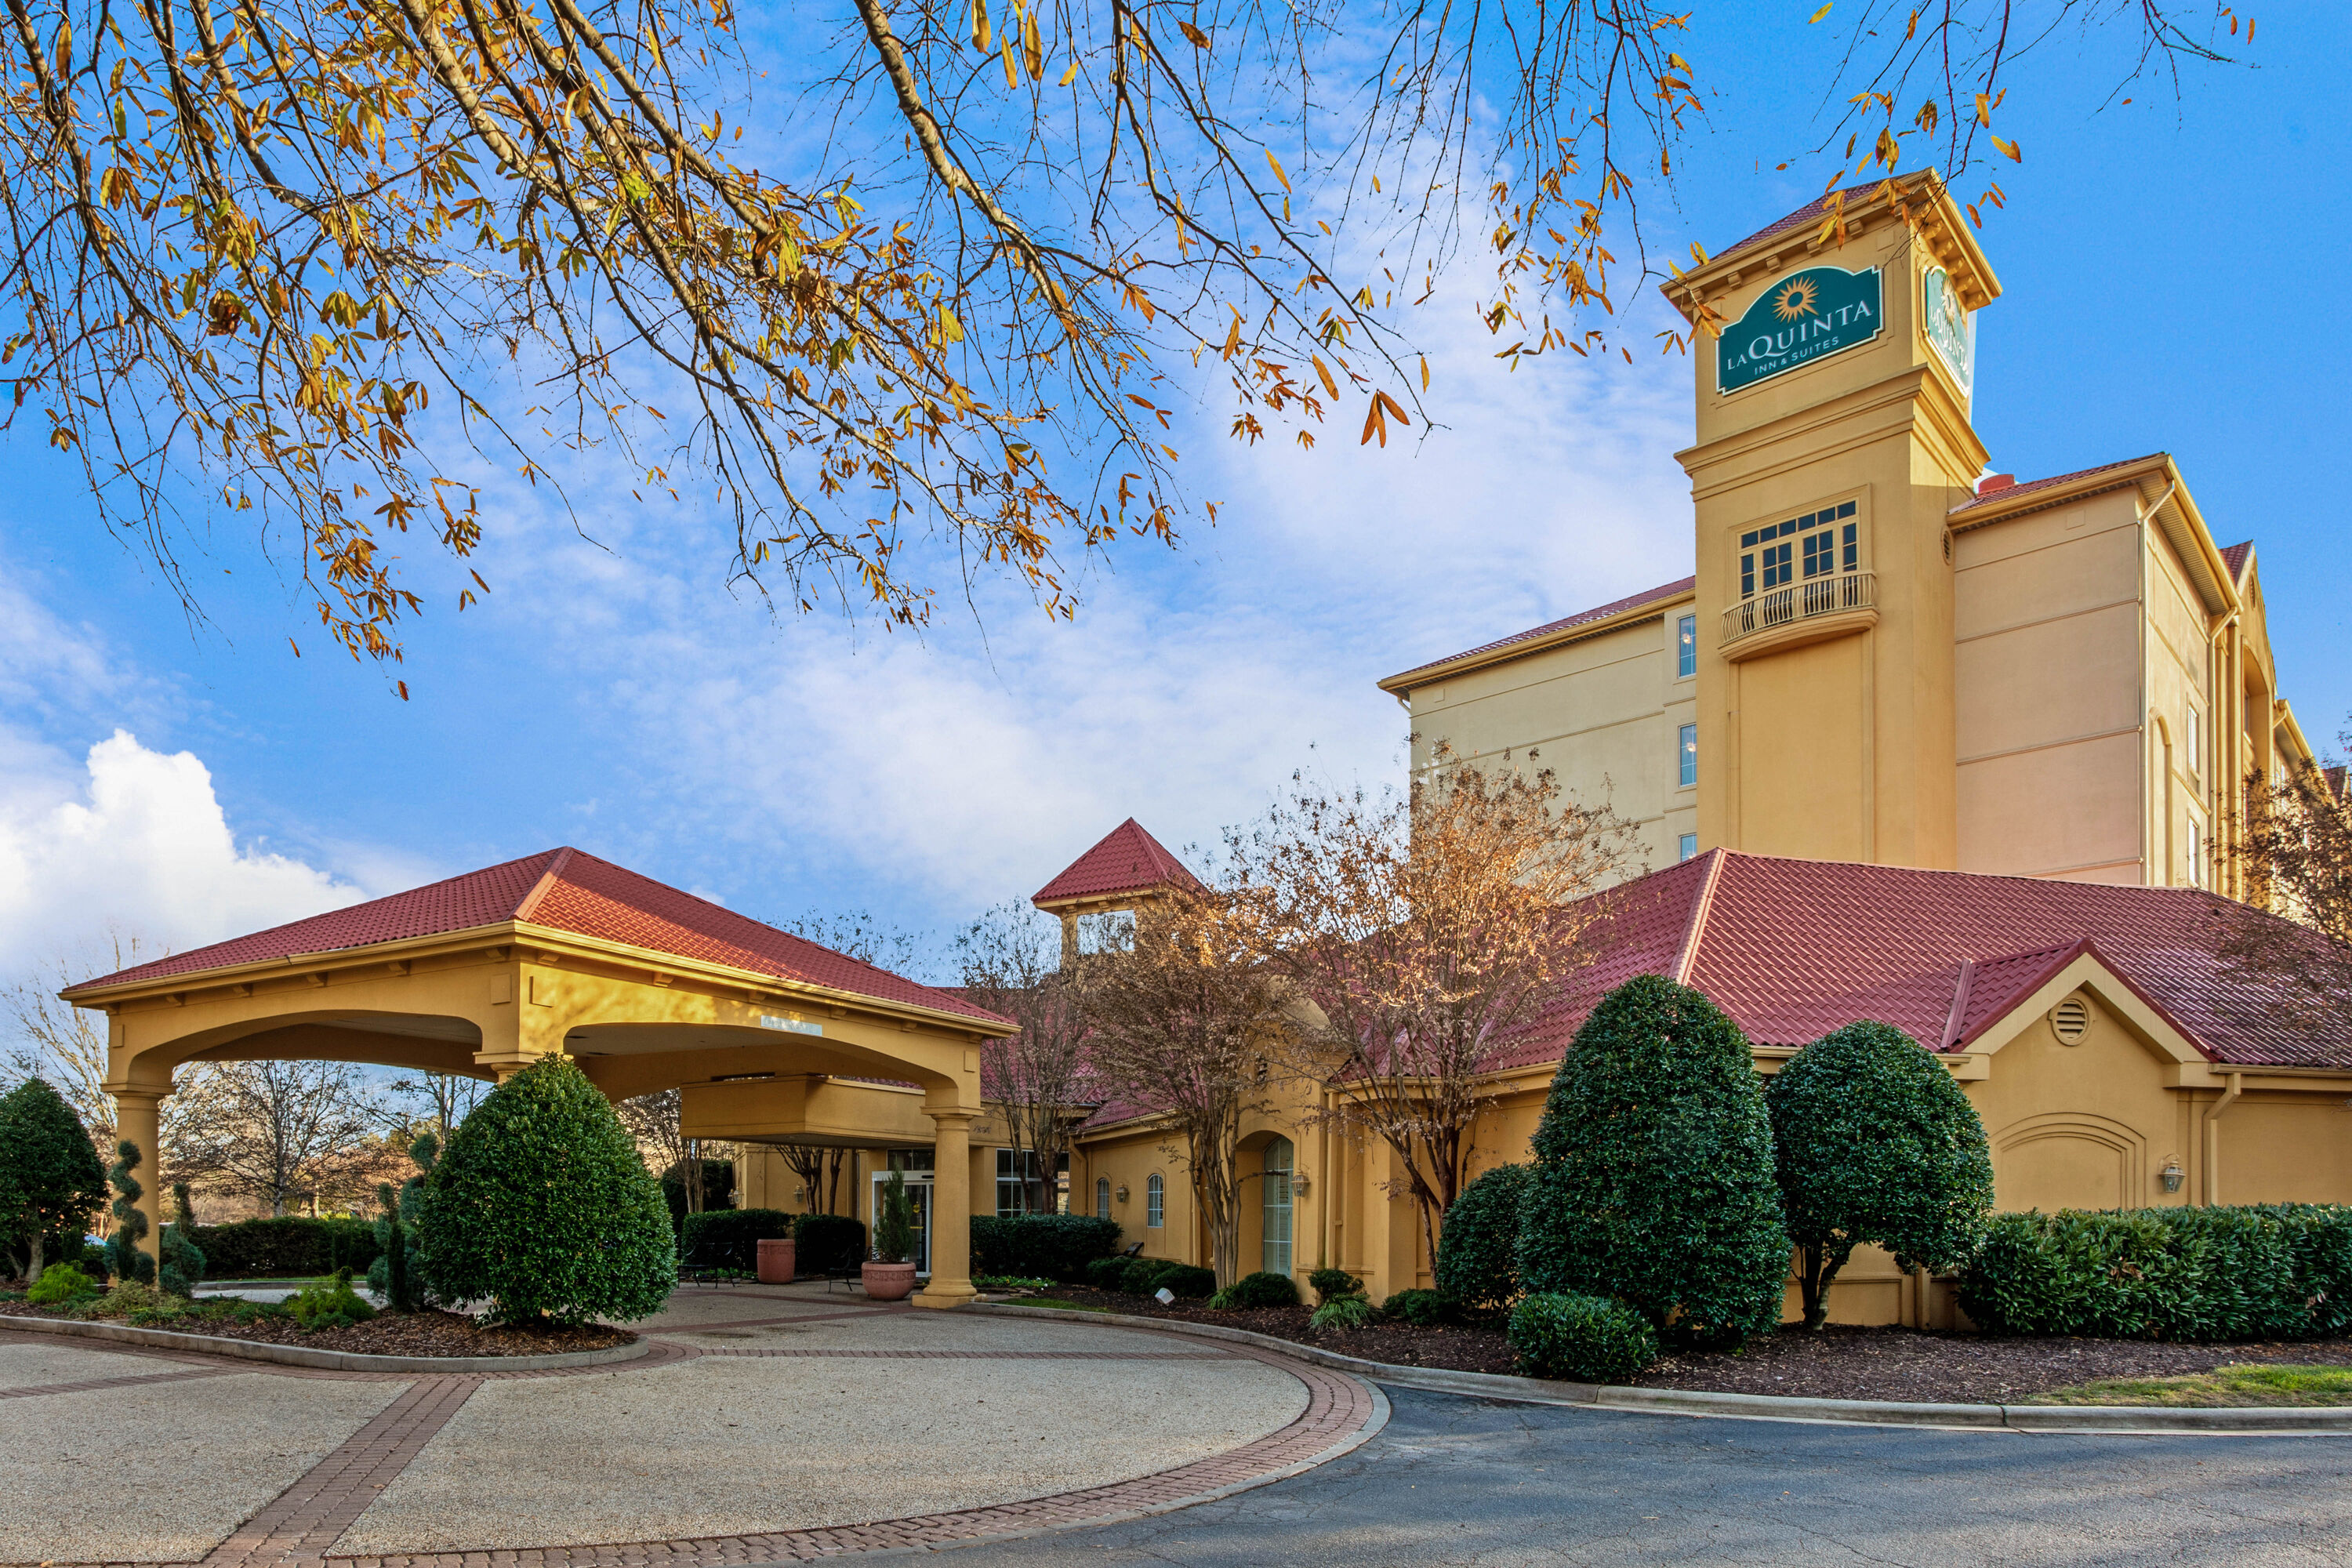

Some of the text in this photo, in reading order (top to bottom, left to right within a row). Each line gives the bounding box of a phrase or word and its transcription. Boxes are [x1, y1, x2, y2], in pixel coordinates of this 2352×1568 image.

[1727, 300, 1872, 370] LA QUINTA
[1754, 336, 1839, 376] INN & SUITES
